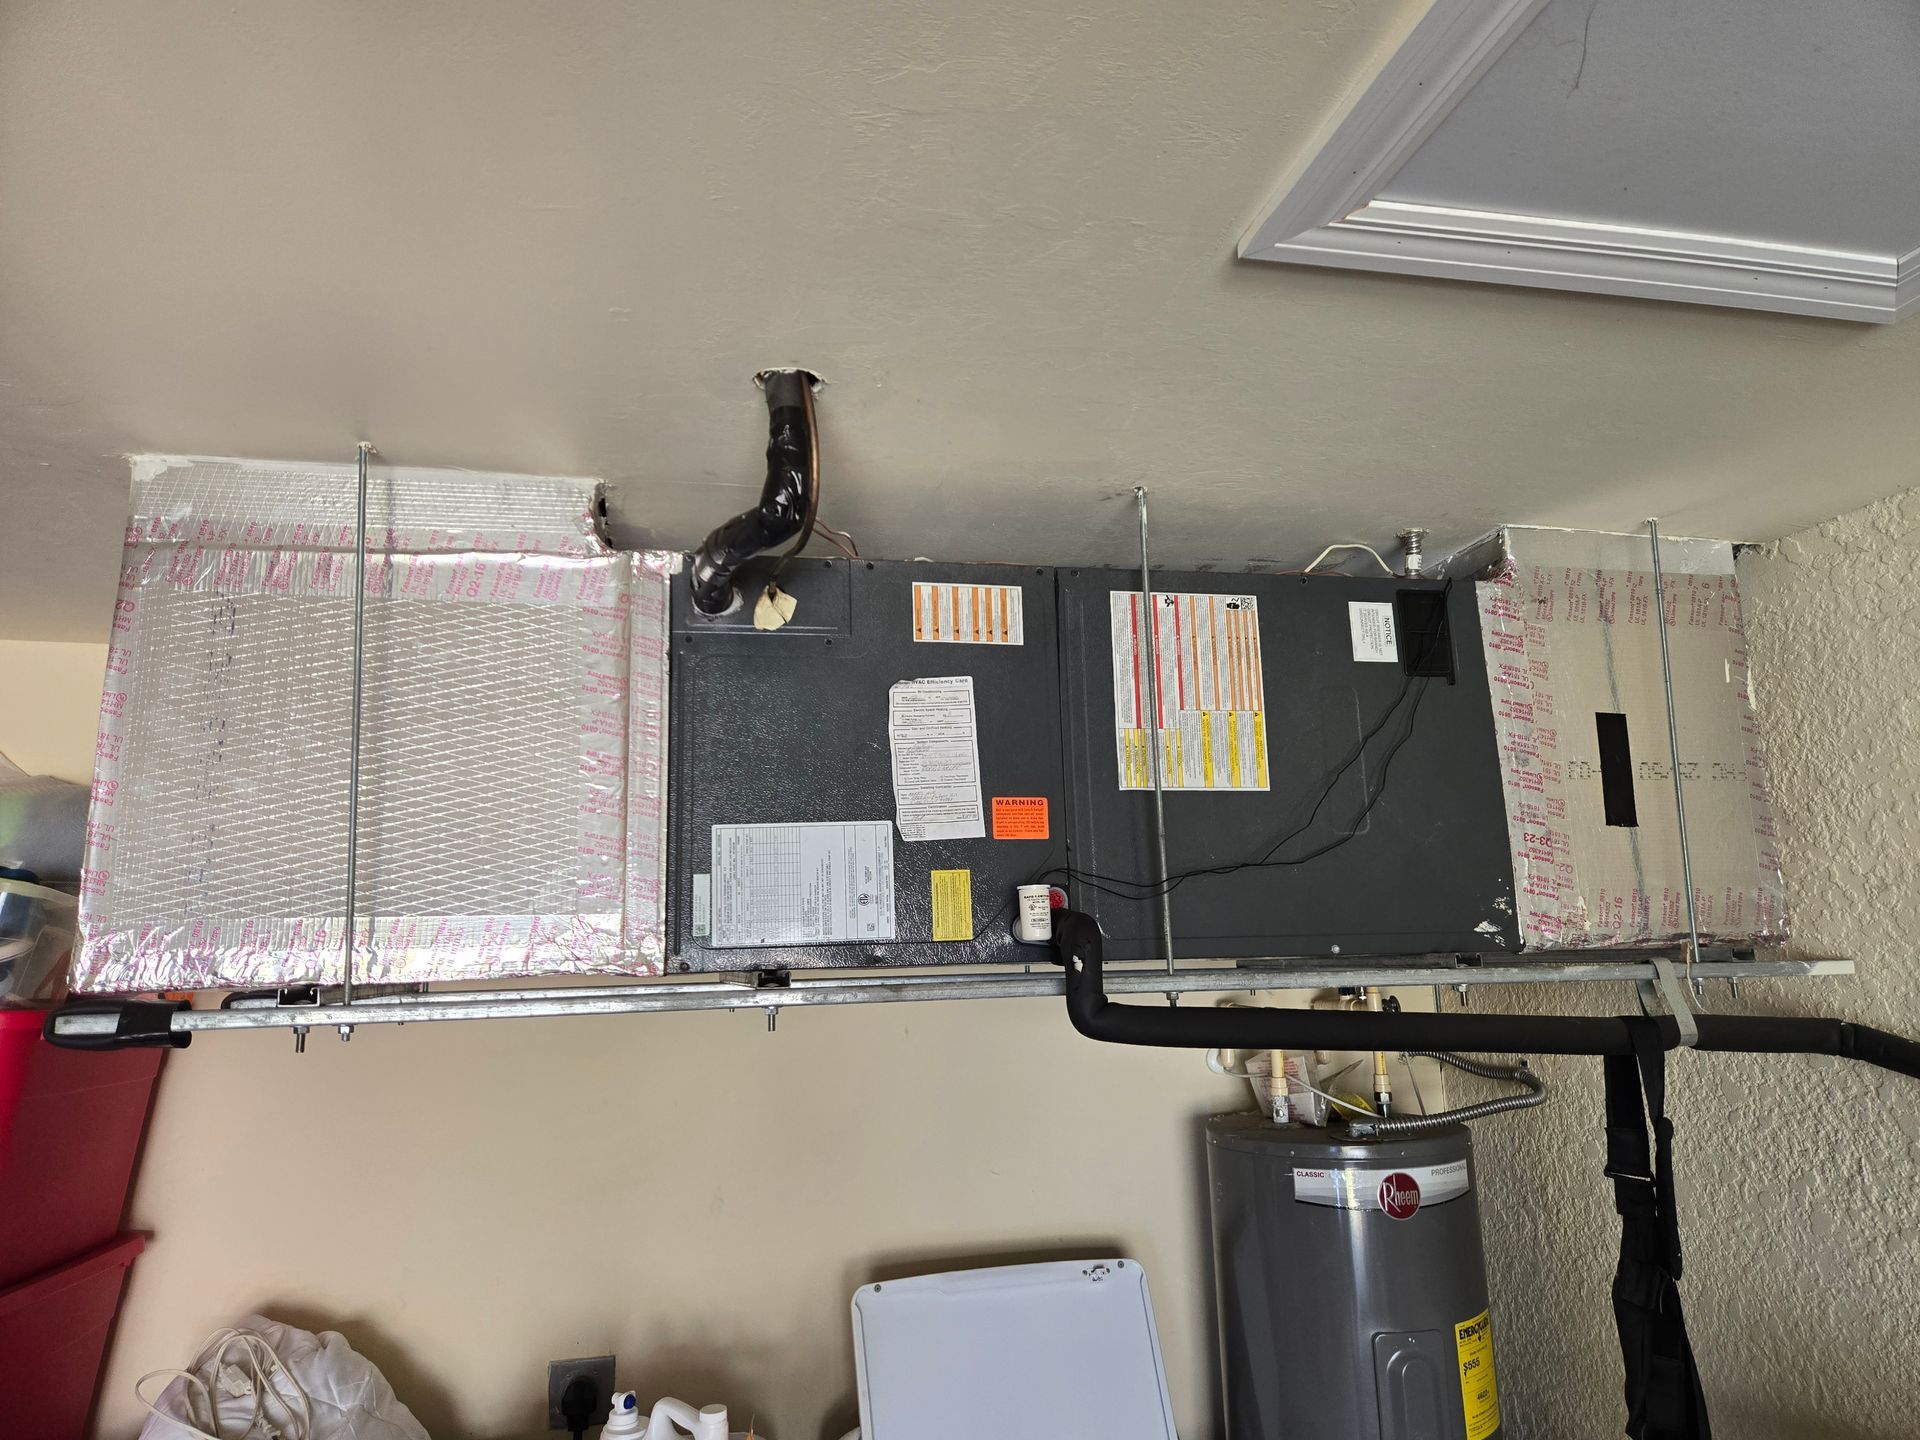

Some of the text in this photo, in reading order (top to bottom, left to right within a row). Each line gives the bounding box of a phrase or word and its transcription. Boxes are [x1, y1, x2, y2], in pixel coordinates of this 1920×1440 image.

[466, 562, 486, 597] Q2-16
[1384, 617, 1393, 645] NOTICE
[1523, 832, 1553, 847] Q3-23
[1612, 896, 1623, 929] Q2-16
[1382, 1174, 1419, 1213] Rheem
[1463, 1357, 1480, 1372] $555
